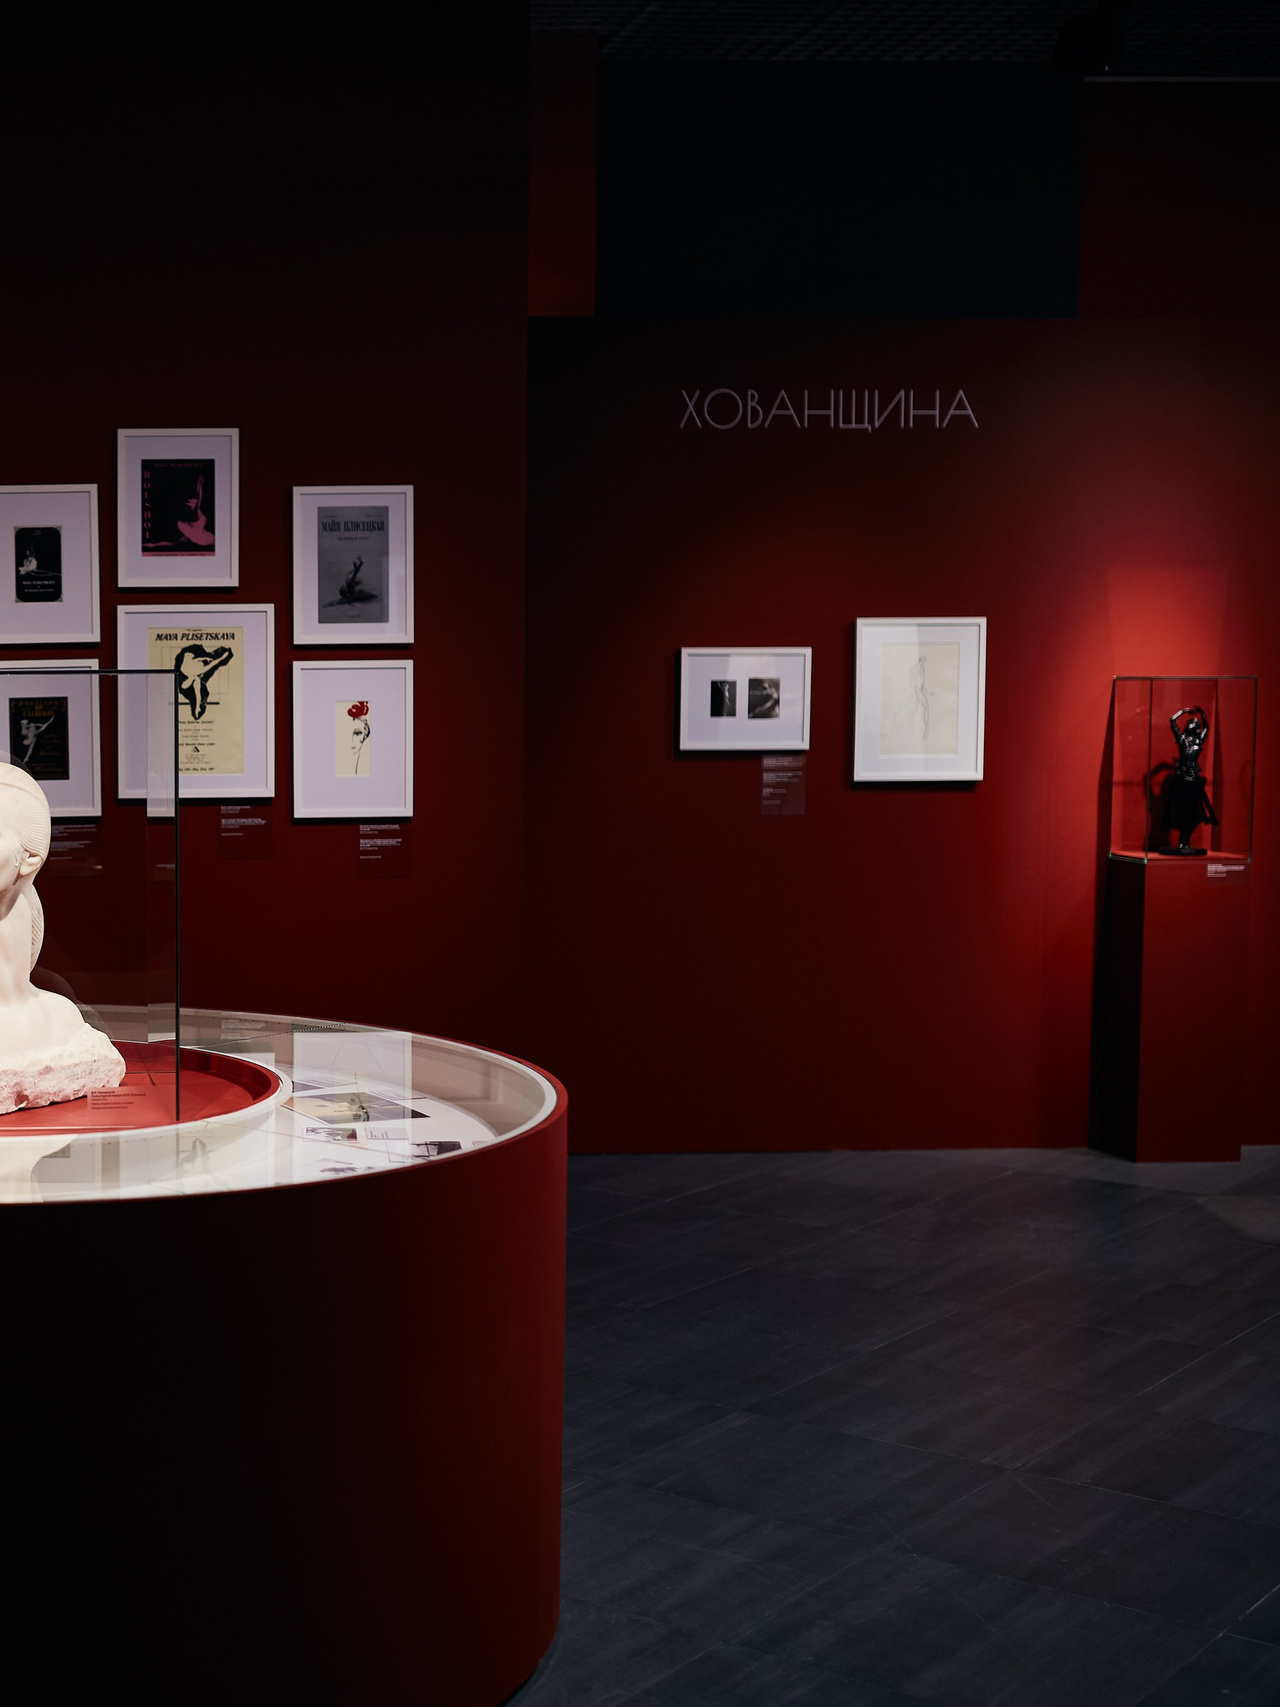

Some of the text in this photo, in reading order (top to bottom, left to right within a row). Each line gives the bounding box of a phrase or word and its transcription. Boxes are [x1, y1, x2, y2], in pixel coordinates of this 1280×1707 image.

[679, 387, 979, 433] ХОВАНЩИНА
[321, 519, 384, 533] МАЙЯ ПЛИСЕЦКАЯ
[180, 632, 235, 640] PLISETSKAYA
